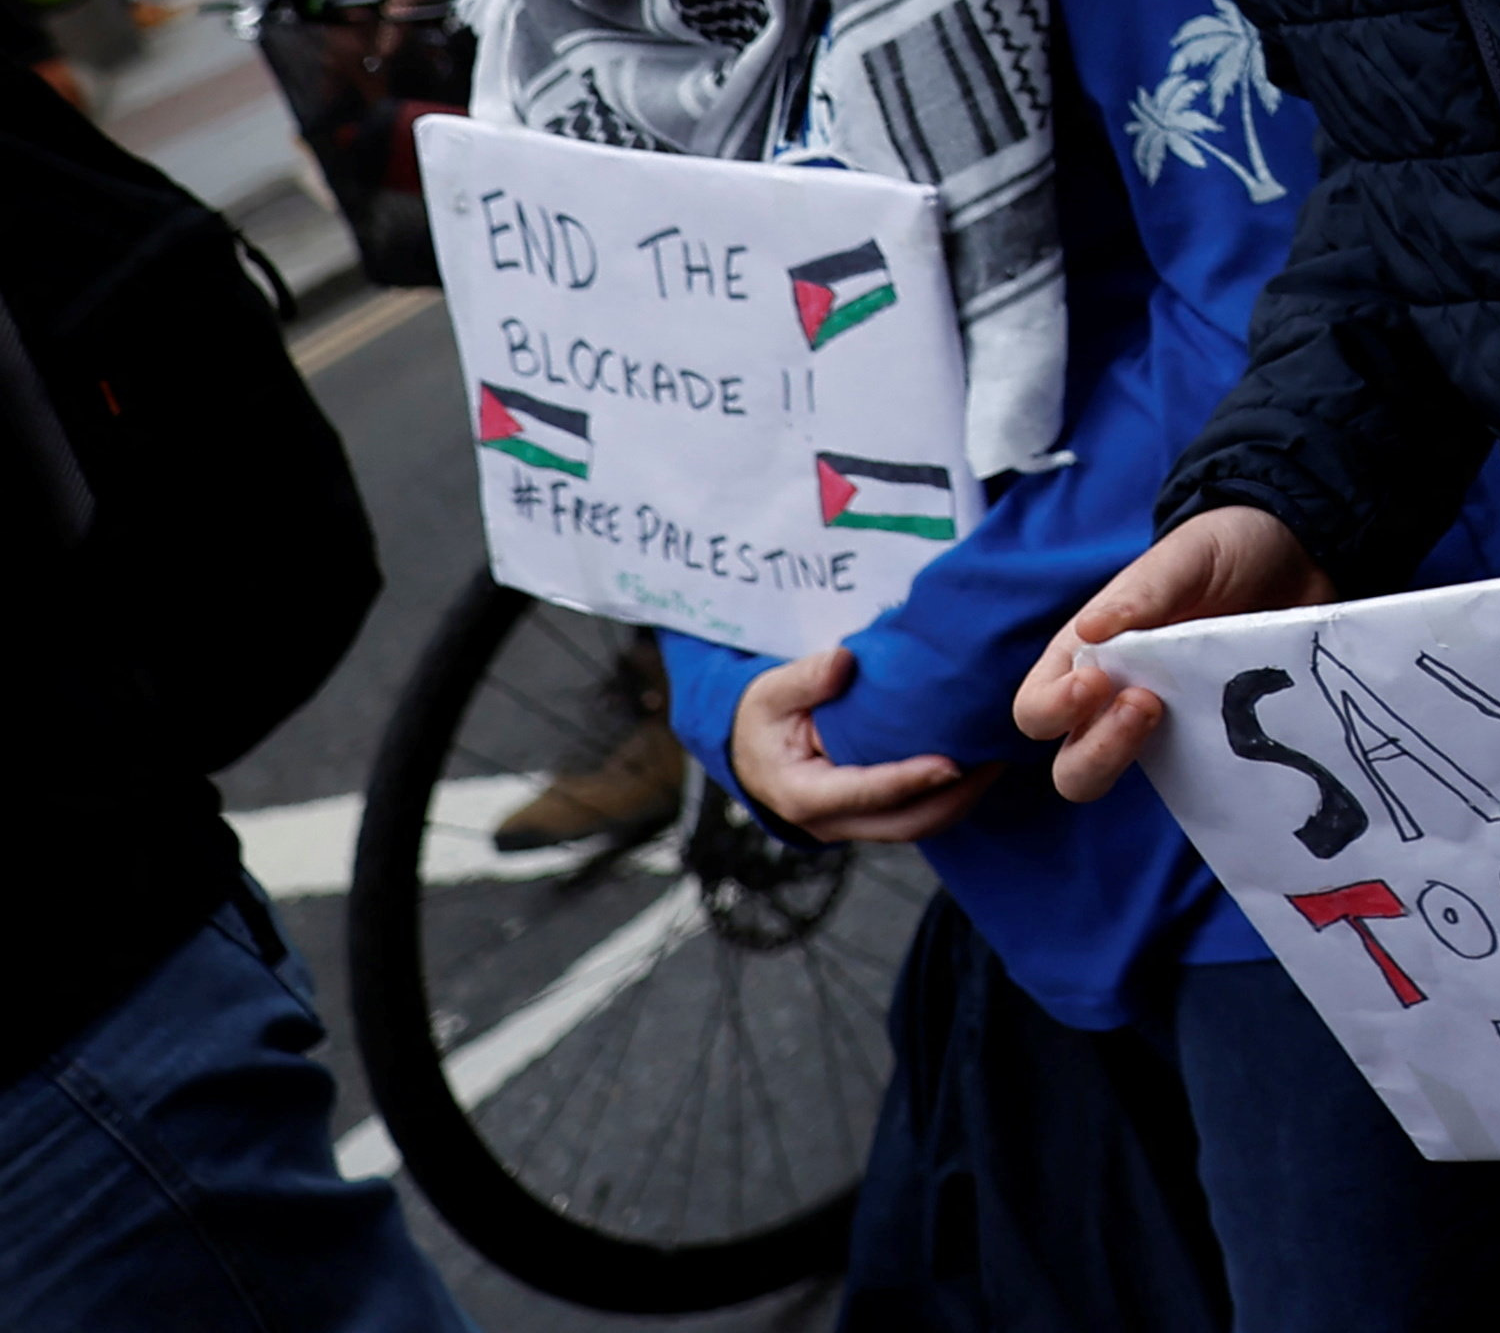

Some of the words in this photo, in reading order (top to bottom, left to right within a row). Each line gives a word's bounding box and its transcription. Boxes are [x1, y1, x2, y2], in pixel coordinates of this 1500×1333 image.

[480, 189, 597, 290] END
[637, 226, 749, 300] THE
[501, 318, 746, 416] BLOCKADE
[635, 503, 858, 593] PALESTINE
